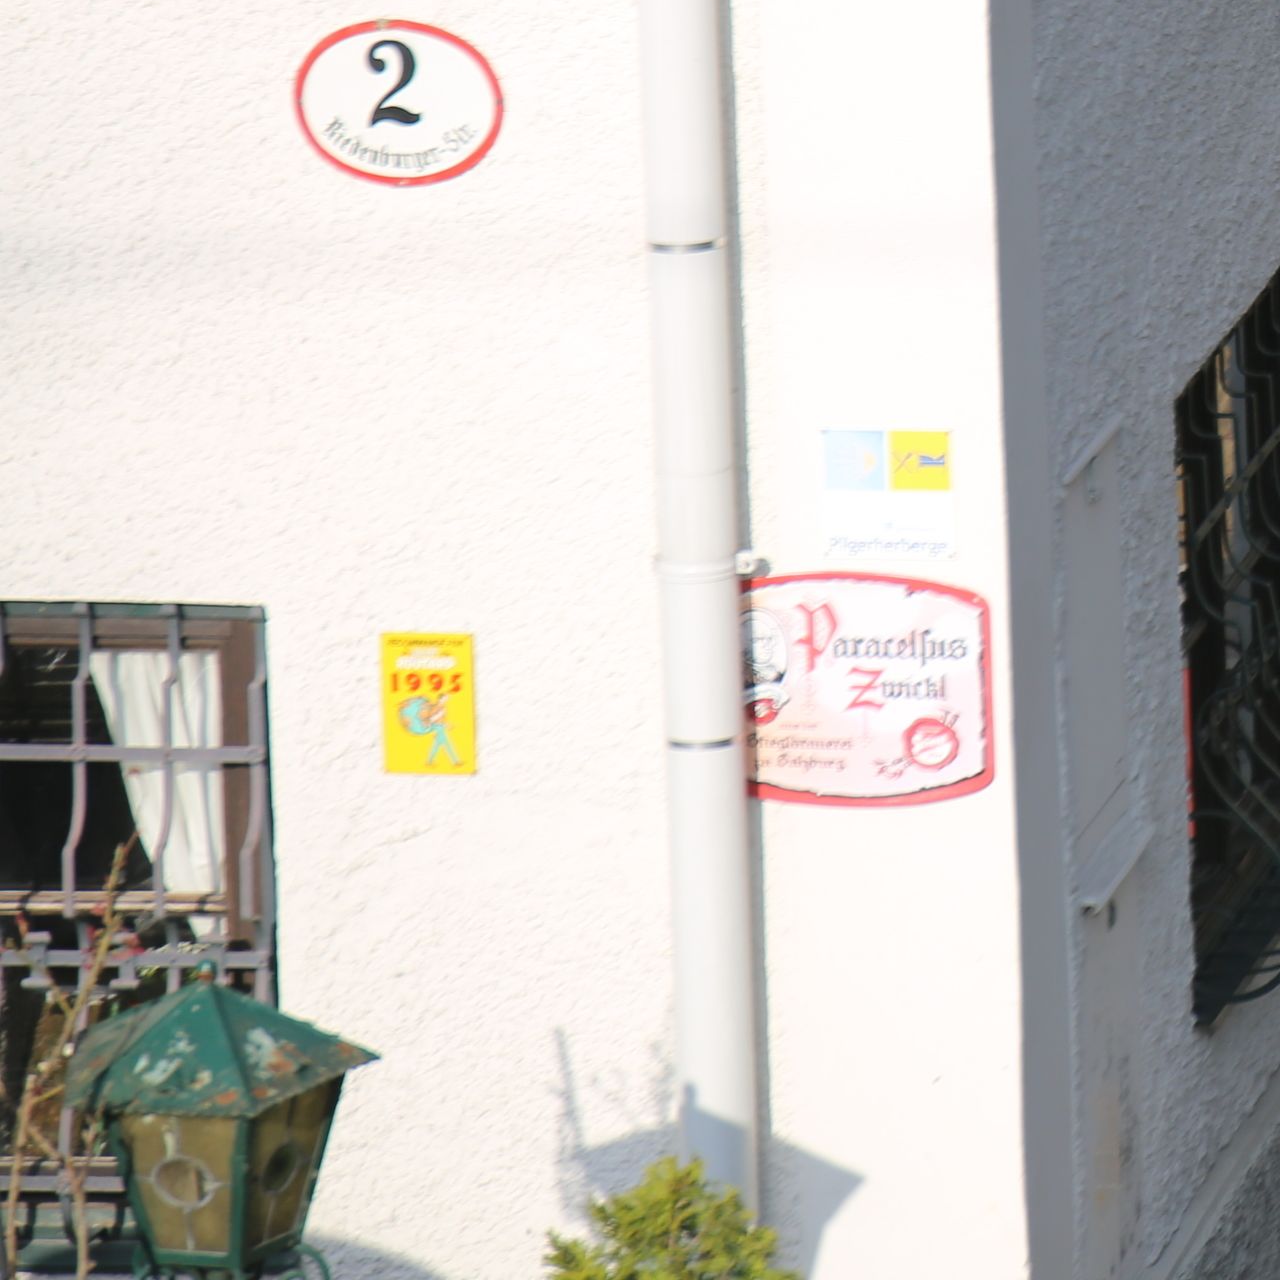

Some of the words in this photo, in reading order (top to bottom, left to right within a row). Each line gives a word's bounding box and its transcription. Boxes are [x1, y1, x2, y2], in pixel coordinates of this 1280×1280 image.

[368, 40, 422, 128] 2
[389, 673, 464, 695] 1995
[846, 666, 948, 711] Zwickl
